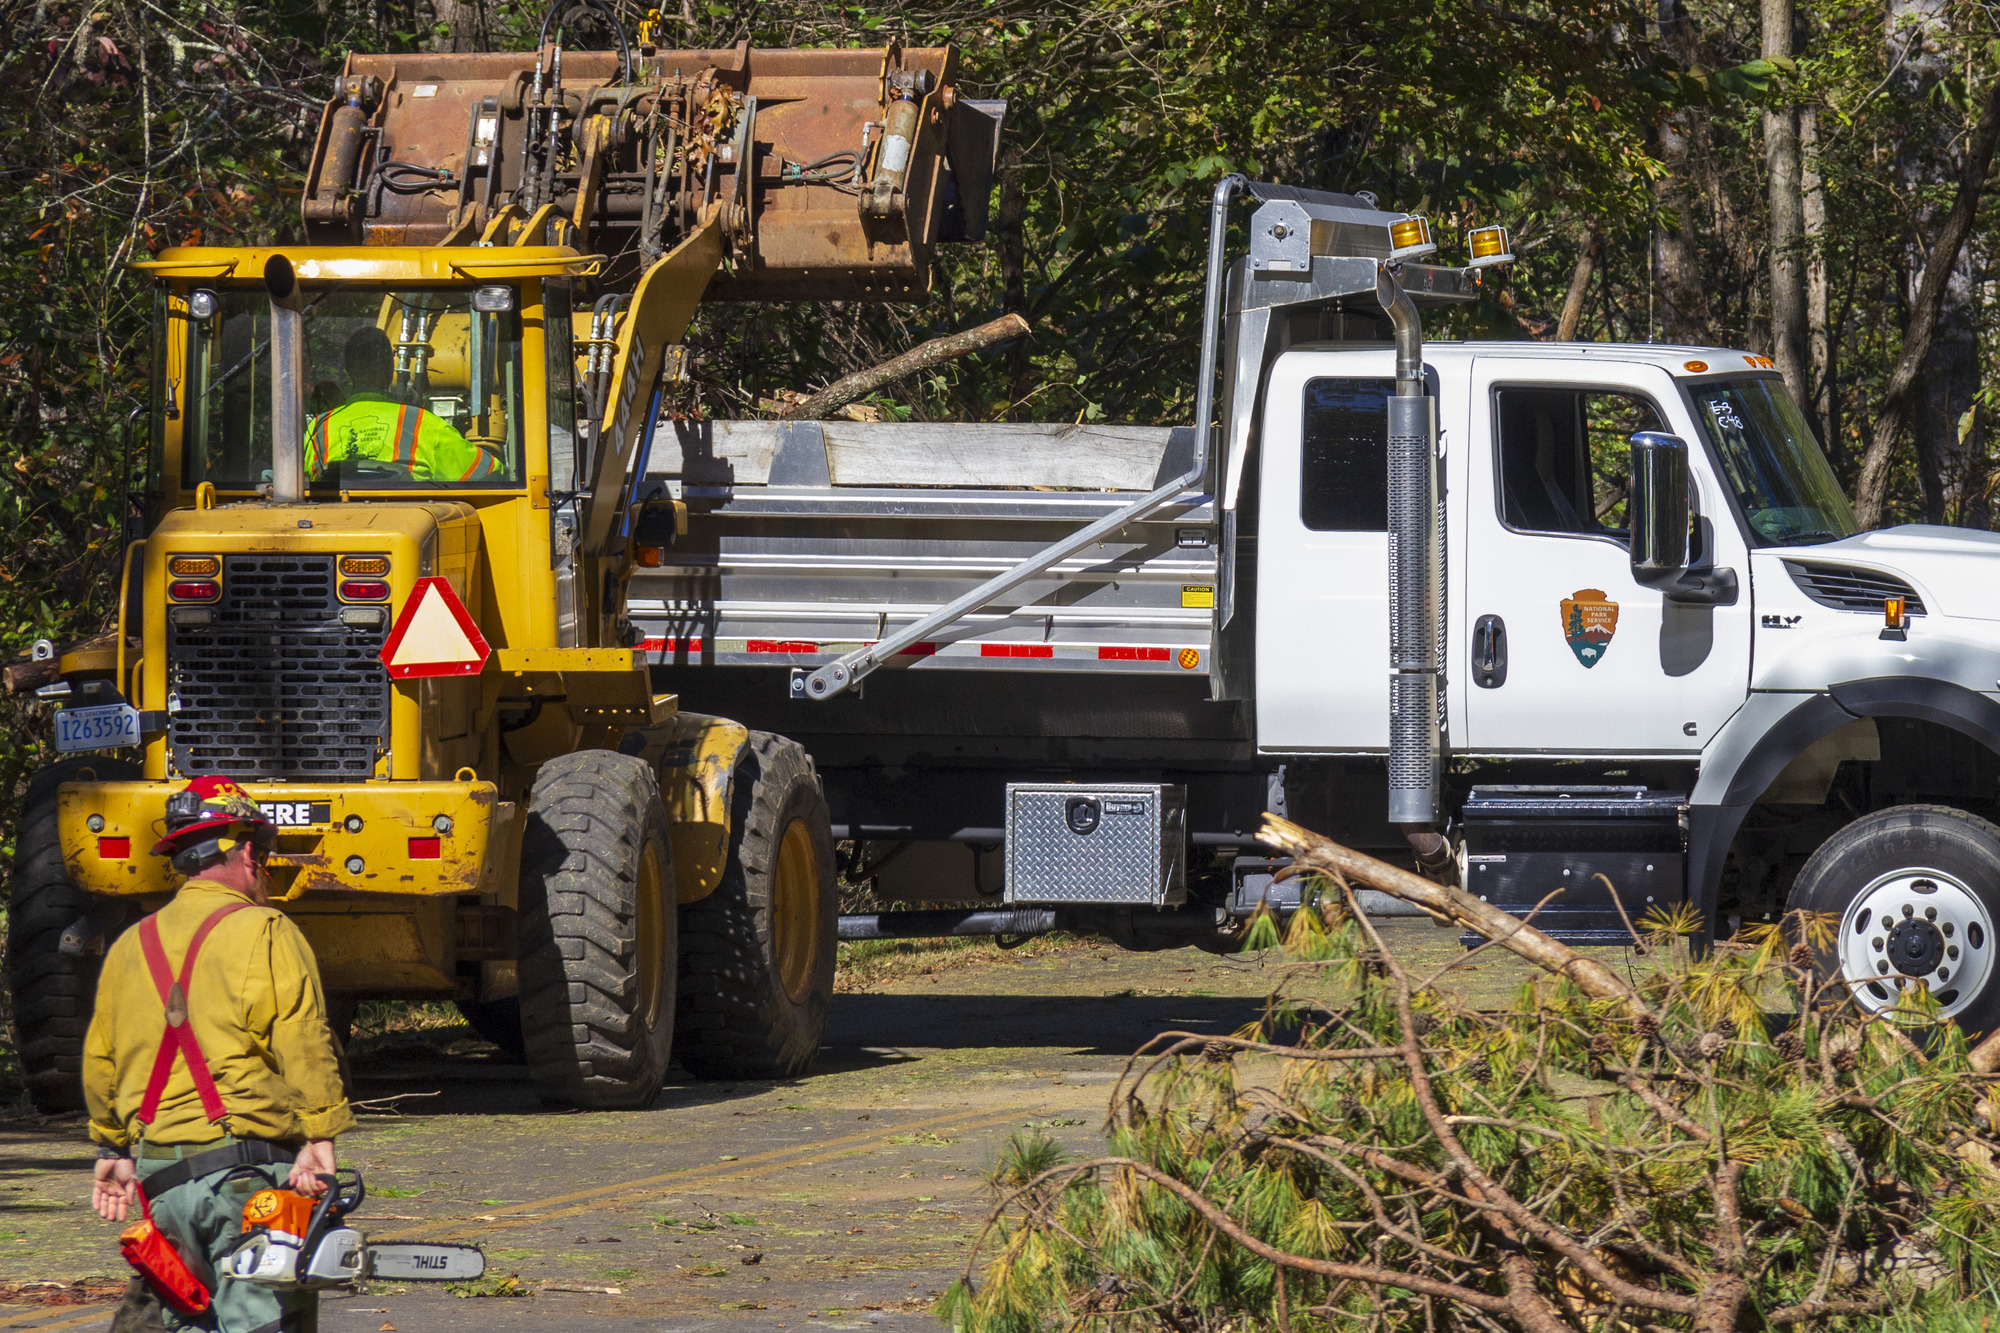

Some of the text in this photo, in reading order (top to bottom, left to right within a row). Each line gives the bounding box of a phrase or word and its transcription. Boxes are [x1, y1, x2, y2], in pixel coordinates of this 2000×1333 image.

[614, 329, 645, 458] 444H
[260, 803, 310, 825] ERE
[413, 1255, 448, 1269] STIHL
